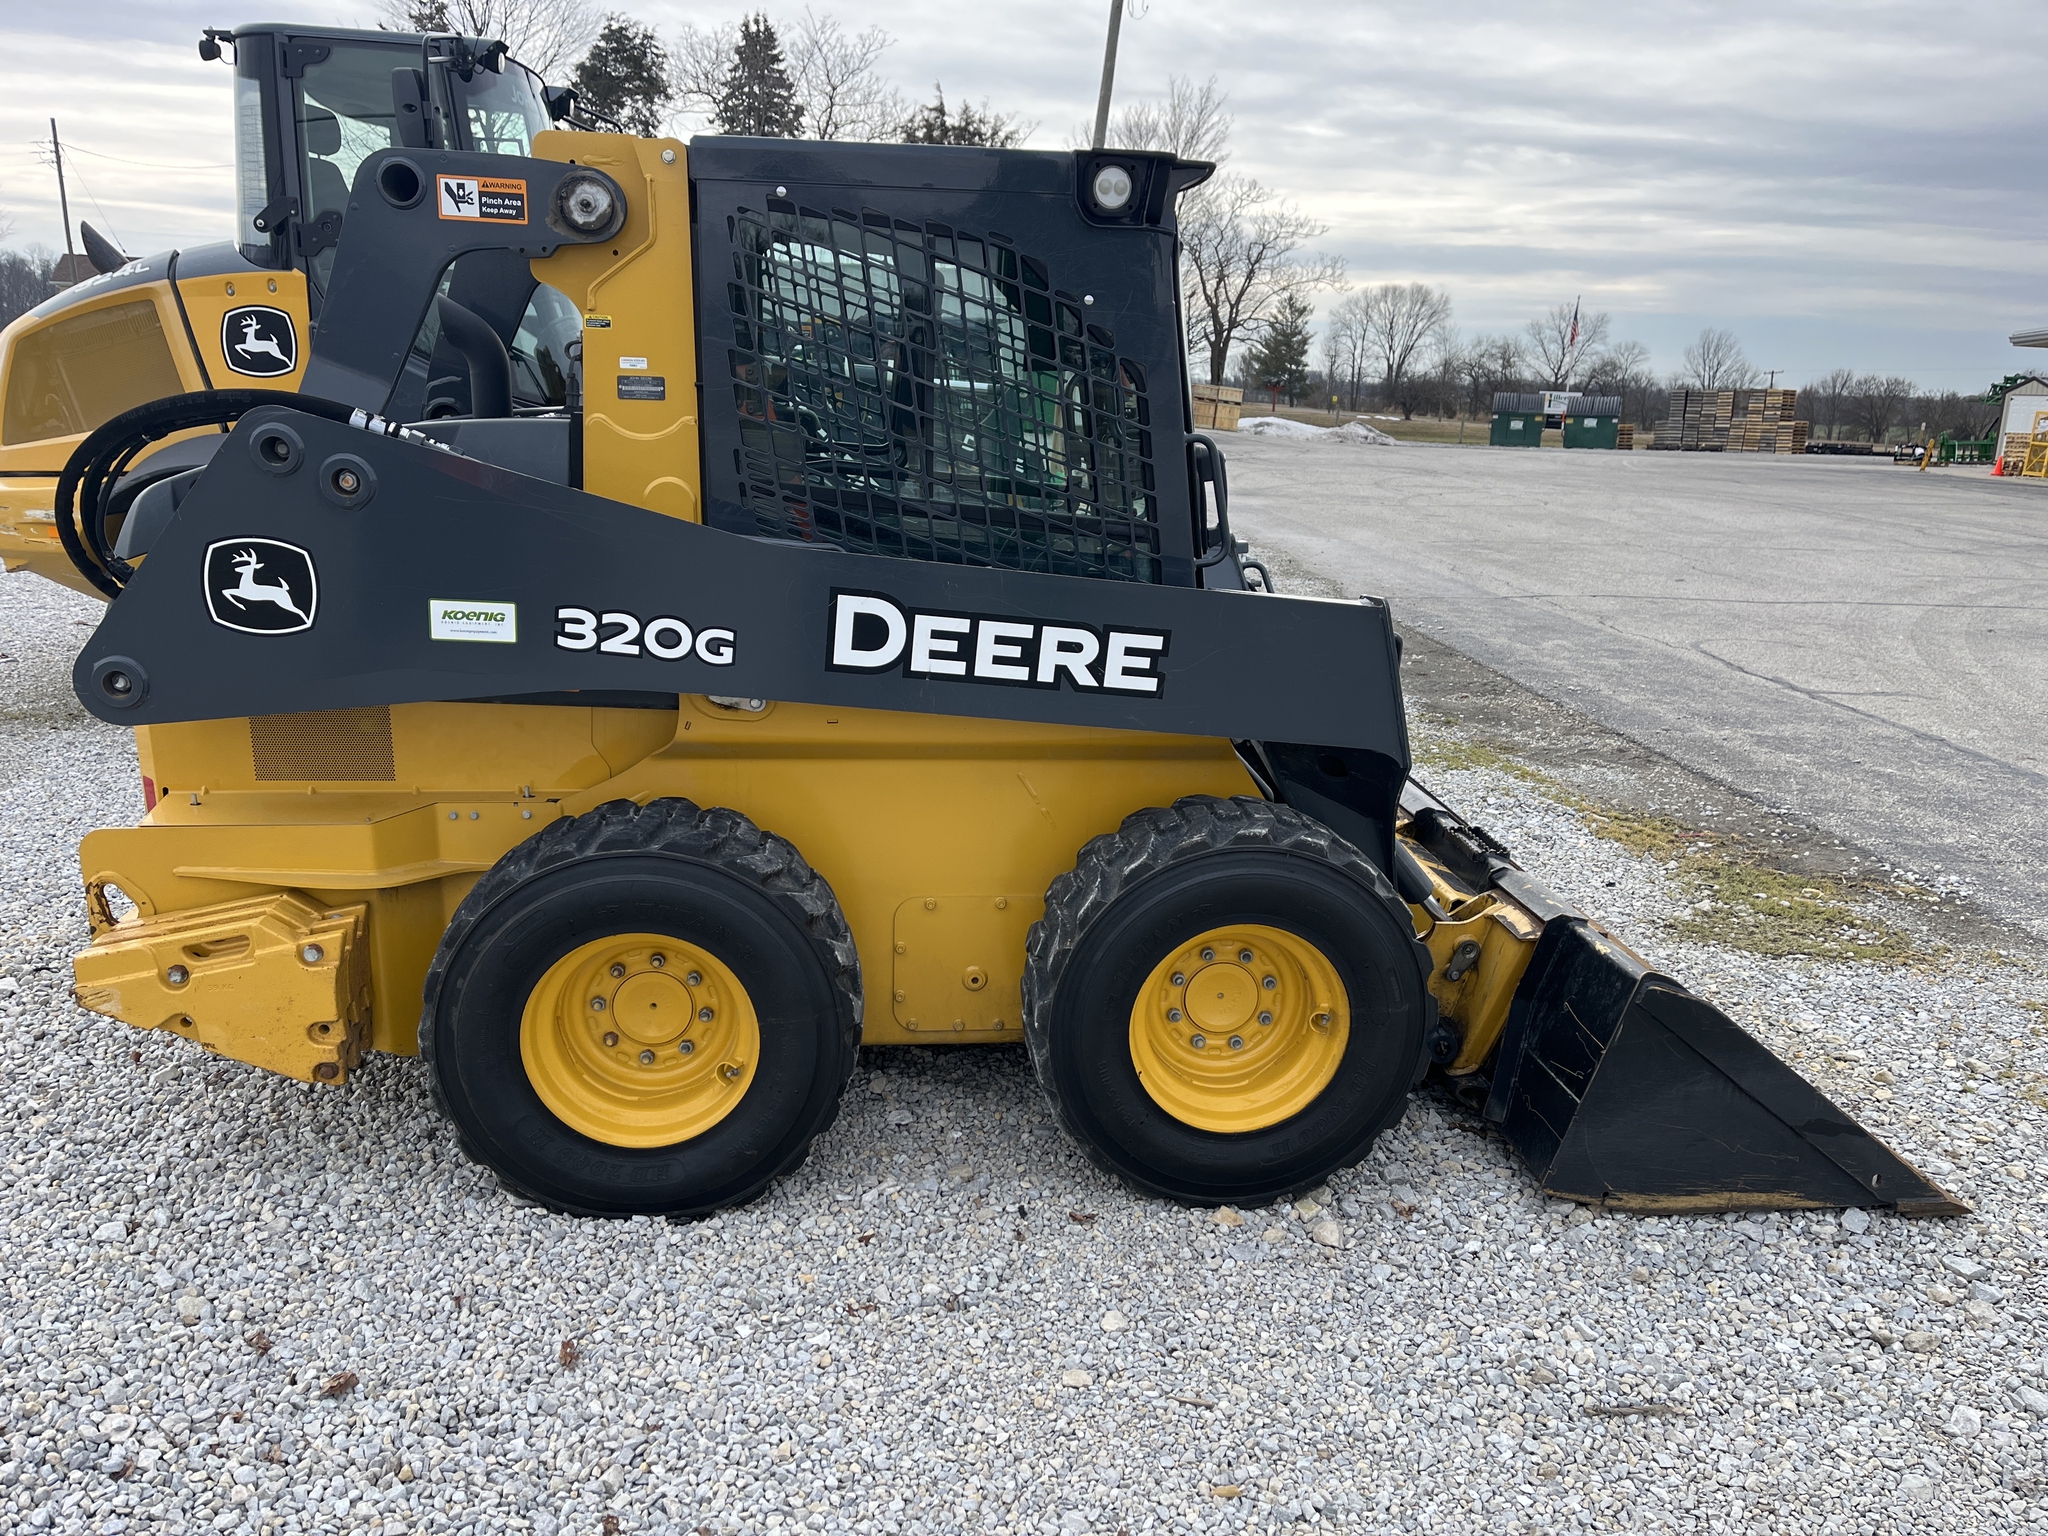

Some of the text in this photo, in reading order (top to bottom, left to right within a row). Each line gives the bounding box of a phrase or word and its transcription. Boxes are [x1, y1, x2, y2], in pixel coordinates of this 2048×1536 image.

[481, 196, 522, 207] Pinch Area
[488, 181, 523, 191] WARNING
[481, 206, 517, 217] Keep Away
[556, 607, 735, 666] 320G
[832, 593, 1165, 692] DEERE
[635, 901, 733, 944] TITAN
[1113, 911, 1185, 983] TITAN
[554, 1147, 624, 1180] 2000
